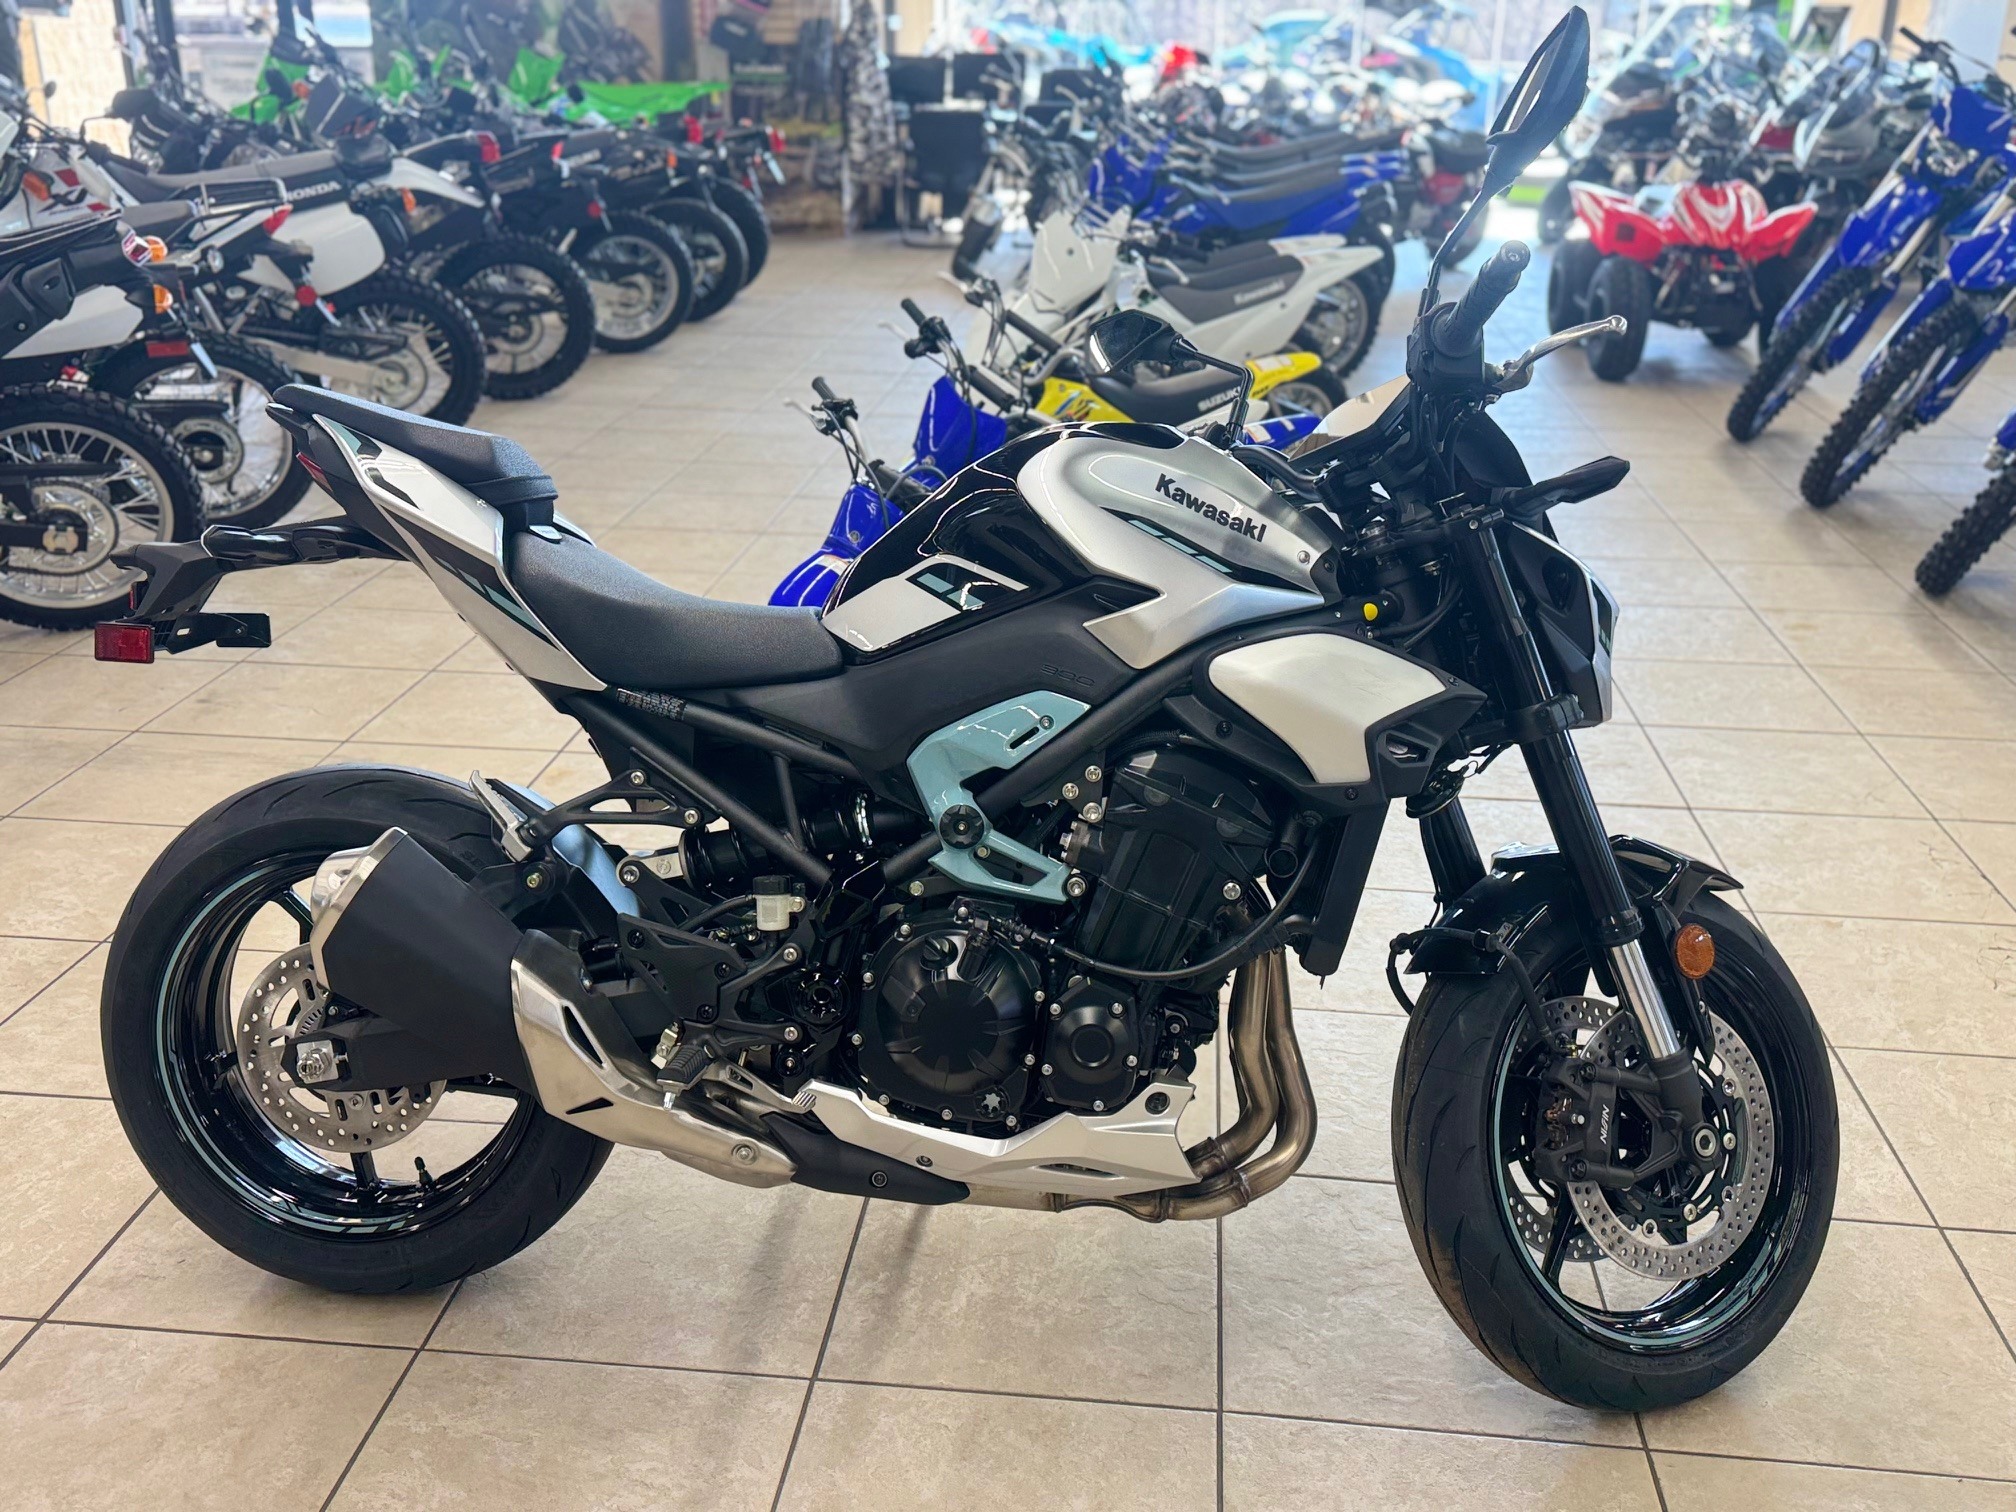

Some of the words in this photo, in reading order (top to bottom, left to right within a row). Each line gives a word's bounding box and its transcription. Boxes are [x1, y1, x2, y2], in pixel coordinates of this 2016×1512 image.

[1155, 472, 1267, 542] Kawasaki
[1041, 664, 1095, 687] 900
[1600, 1103, 1610, 1145] NISSIN
